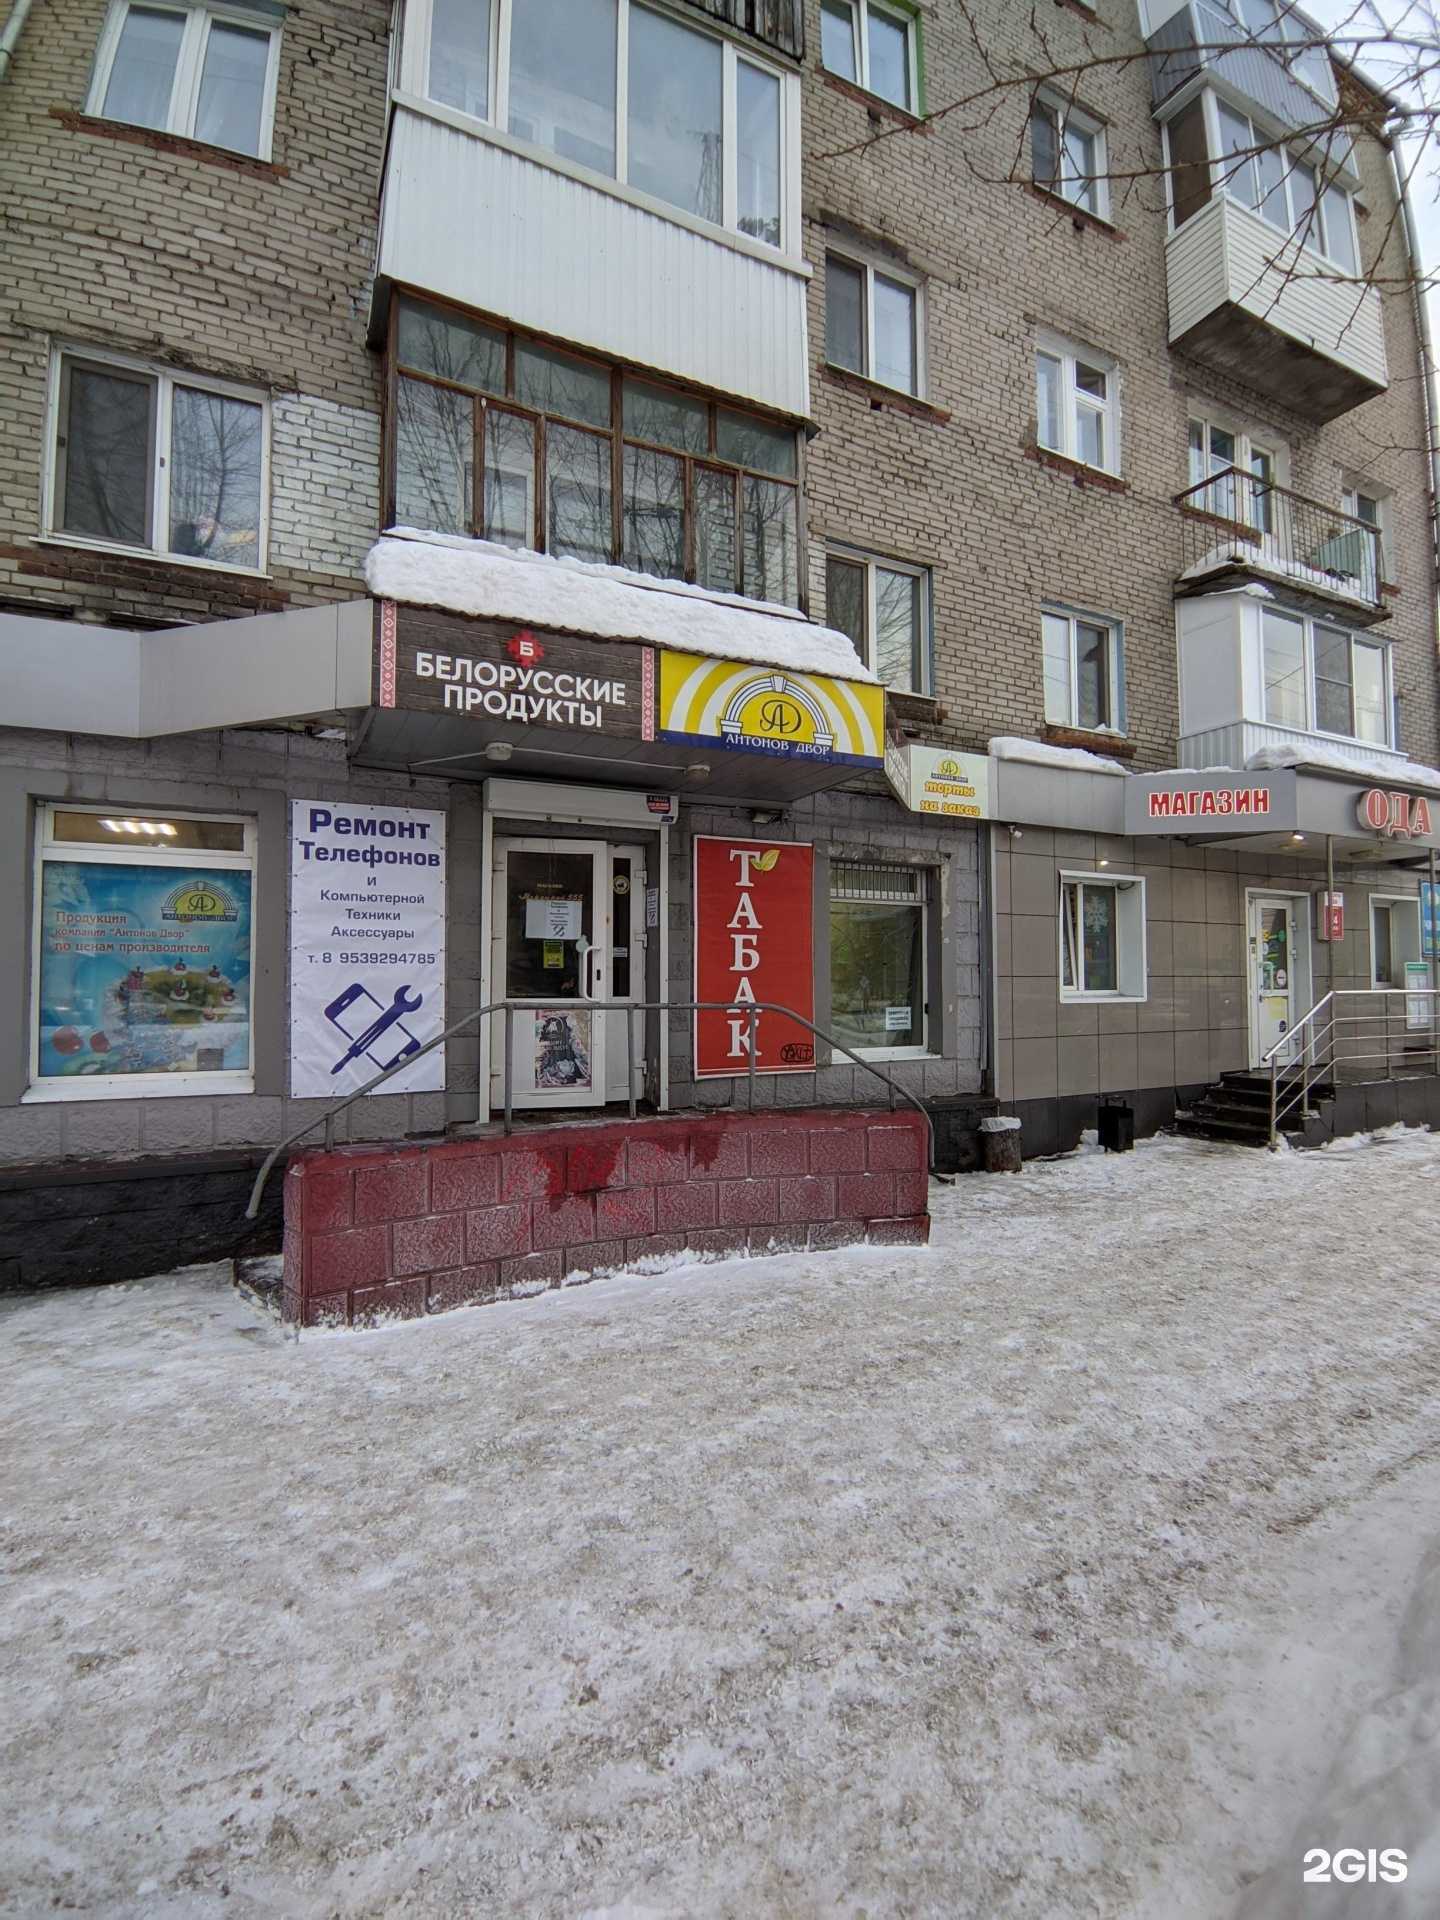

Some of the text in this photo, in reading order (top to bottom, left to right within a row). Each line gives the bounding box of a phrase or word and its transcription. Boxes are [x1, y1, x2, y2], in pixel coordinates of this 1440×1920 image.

[520, 641, 534, 656] Б
[416, 652, 626, 705] БЕЛОРУССКИЕ
[444, 684, 602, 727] ПРОДУКТЫ
[726, 733, 830, 755] АНТОНОВ ДВОР
[920, 800, 981, 817] на заказ
[1149, 788, 1270, 817] МАГАЗИН
[1364, 788, 1433, 838] ОДА
[309, 808, 430, 839] Ремонт
[299, 841, 440, 868] Телефонов
[320, 889, 425, 905] Компьютерной
[55, 911, 127, 924] Продукция
[345, 908, 401, 920] Техники
[331, 926, 415, 940] Аксессуары
[55, 942, 210, 955] по ценам производителя
[322, 952, 332, 963] 8
[339, 952, 436, 964] 9539294785
[726, 849, 763, 1058] ТАБАК
